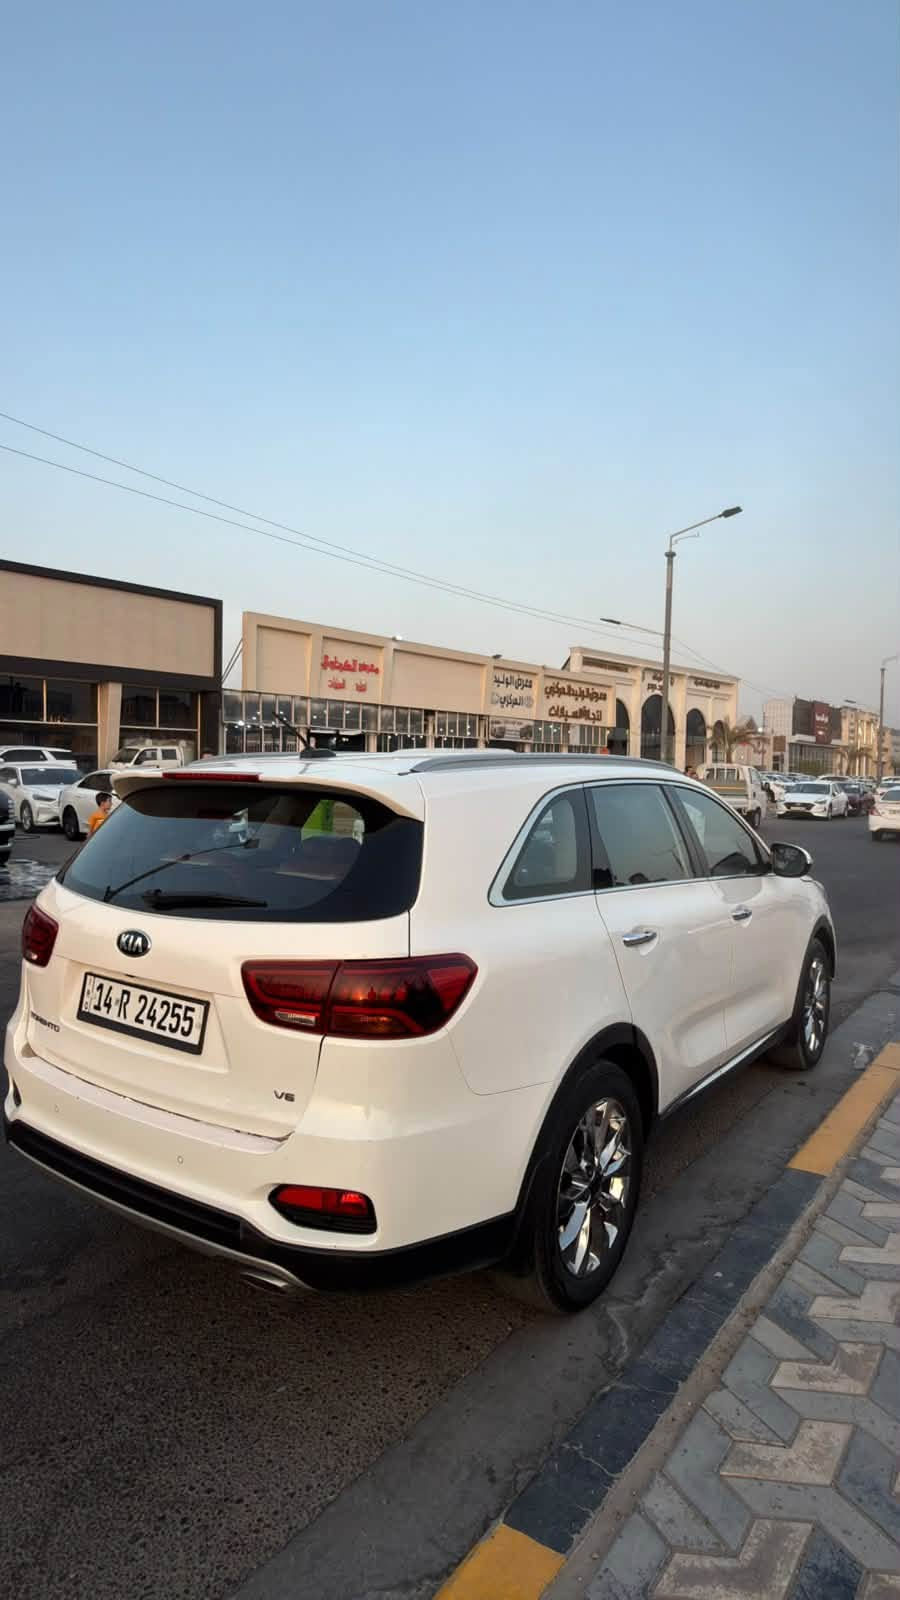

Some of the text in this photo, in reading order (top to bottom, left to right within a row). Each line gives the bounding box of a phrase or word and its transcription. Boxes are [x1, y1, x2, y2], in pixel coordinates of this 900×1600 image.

[494, 673, 533, 690] معرض الوليد
[545, 681, 607, 702] معرض الوليد المركزي
[499, 693, 523, 709] المركزي
[548, 705, 583, 722] السيارات
[120, 934, 143, 952] KIA
[93, 983, 195, 1037] 14 R 24255
[274, 1090, 295, 1103] V6
